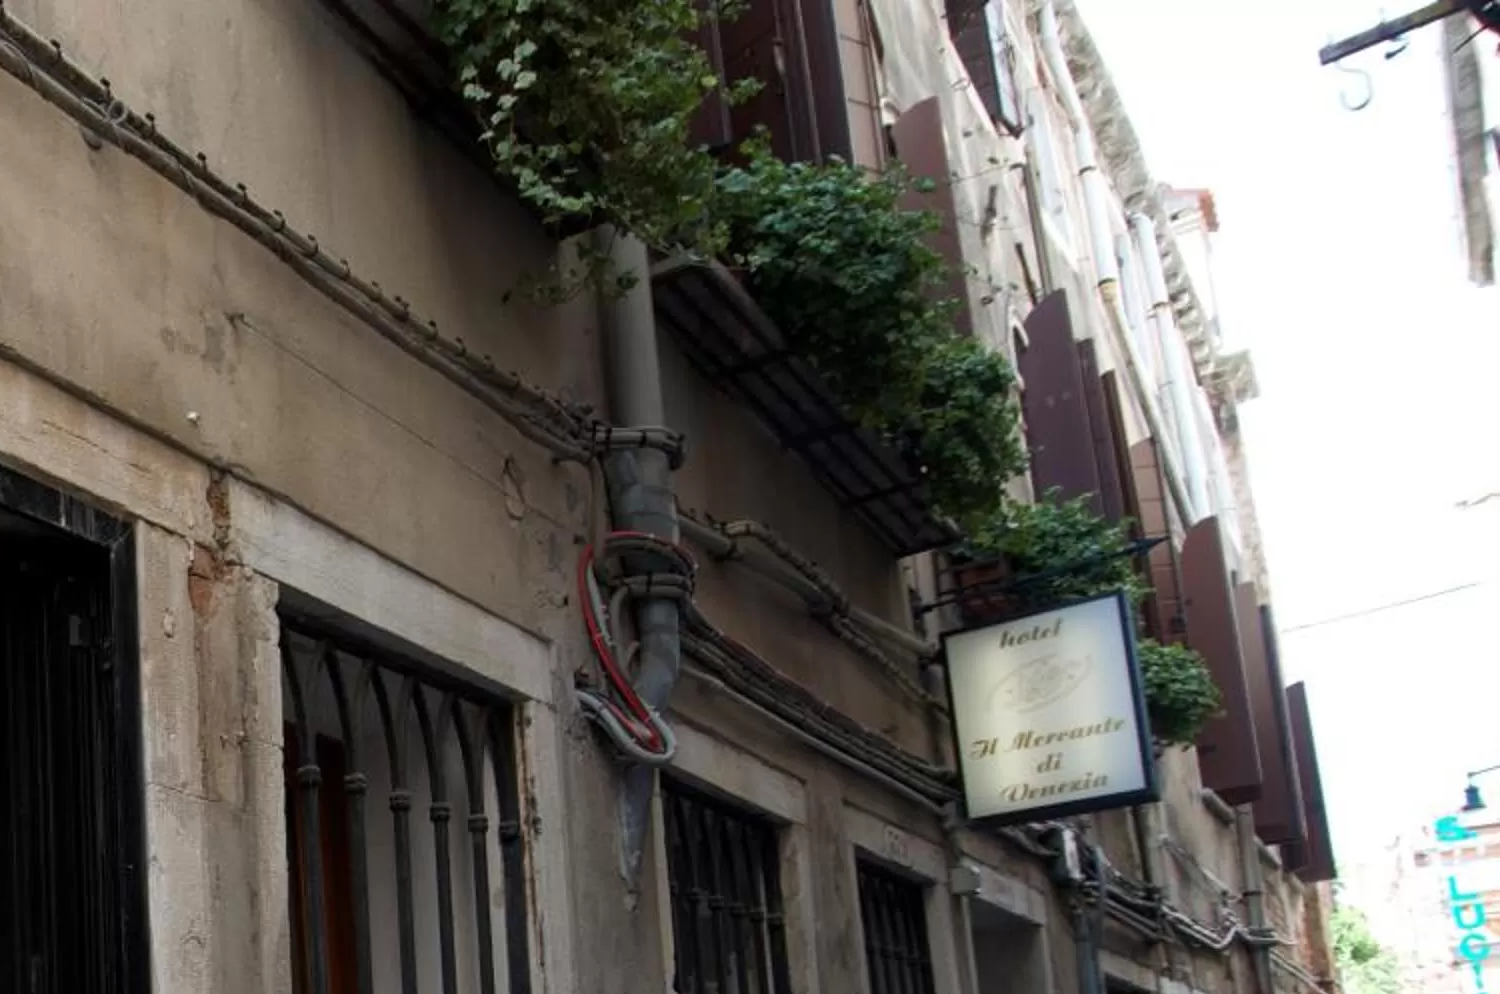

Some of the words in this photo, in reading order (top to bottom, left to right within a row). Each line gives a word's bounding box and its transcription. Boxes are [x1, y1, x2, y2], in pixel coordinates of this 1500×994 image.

[998, 617, 1063, 650] hotel
[968, 738, 998, 760] Il
[1007, 716, 1125, 753] Mercante
[1036, 752, 1063, 774] di
[1001, 771, 1109, 802] Venezia
